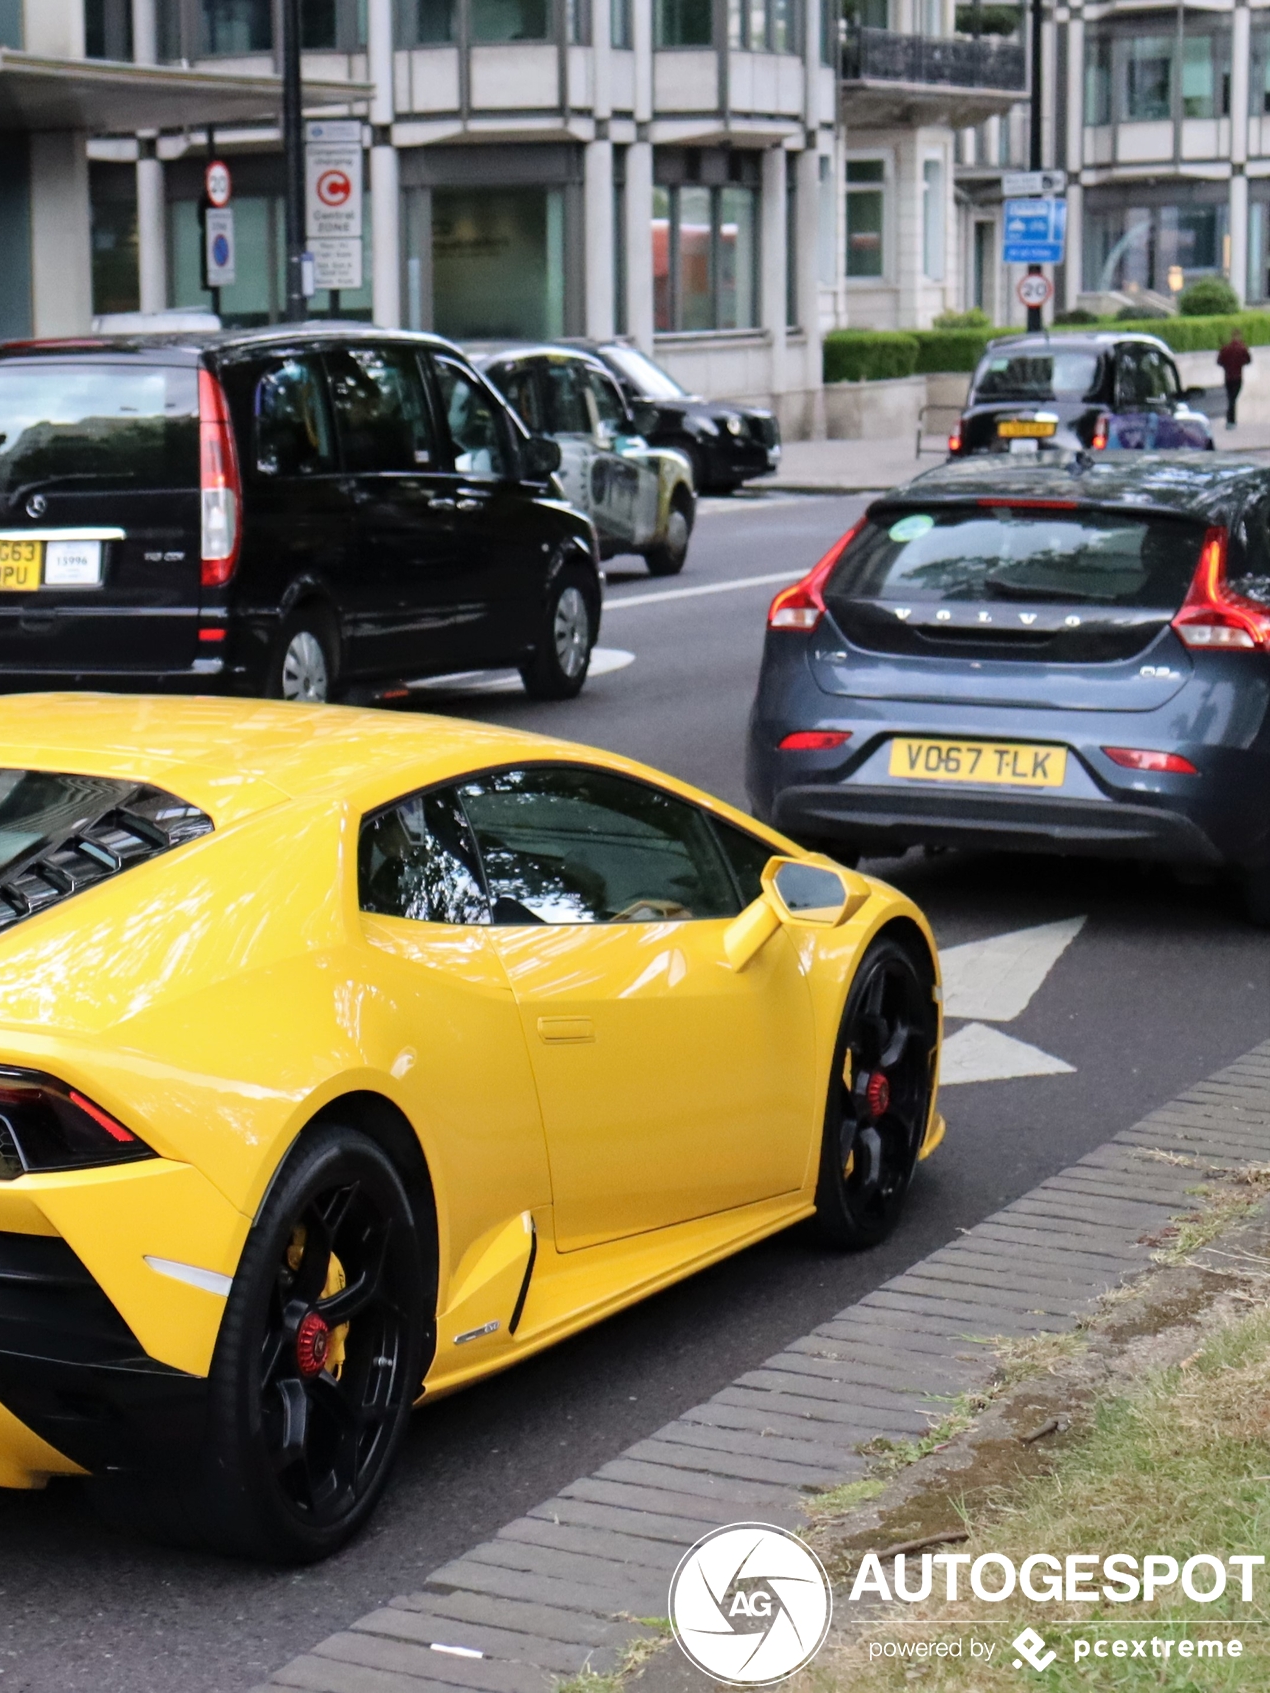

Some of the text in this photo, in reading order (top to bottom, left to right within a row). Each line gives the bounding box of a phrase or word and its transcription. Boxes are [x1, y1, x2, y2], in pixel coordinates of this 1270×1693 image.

[313, 210, 355, 220] Central
[317, 222, 350, 232] ZONE
[1023, 282, 1047, 297] 20
[56, 556, 88, 567] 15996
[893, 607, 1082, 627] VOLVO
[994, 749, 1052, 780] TLK
